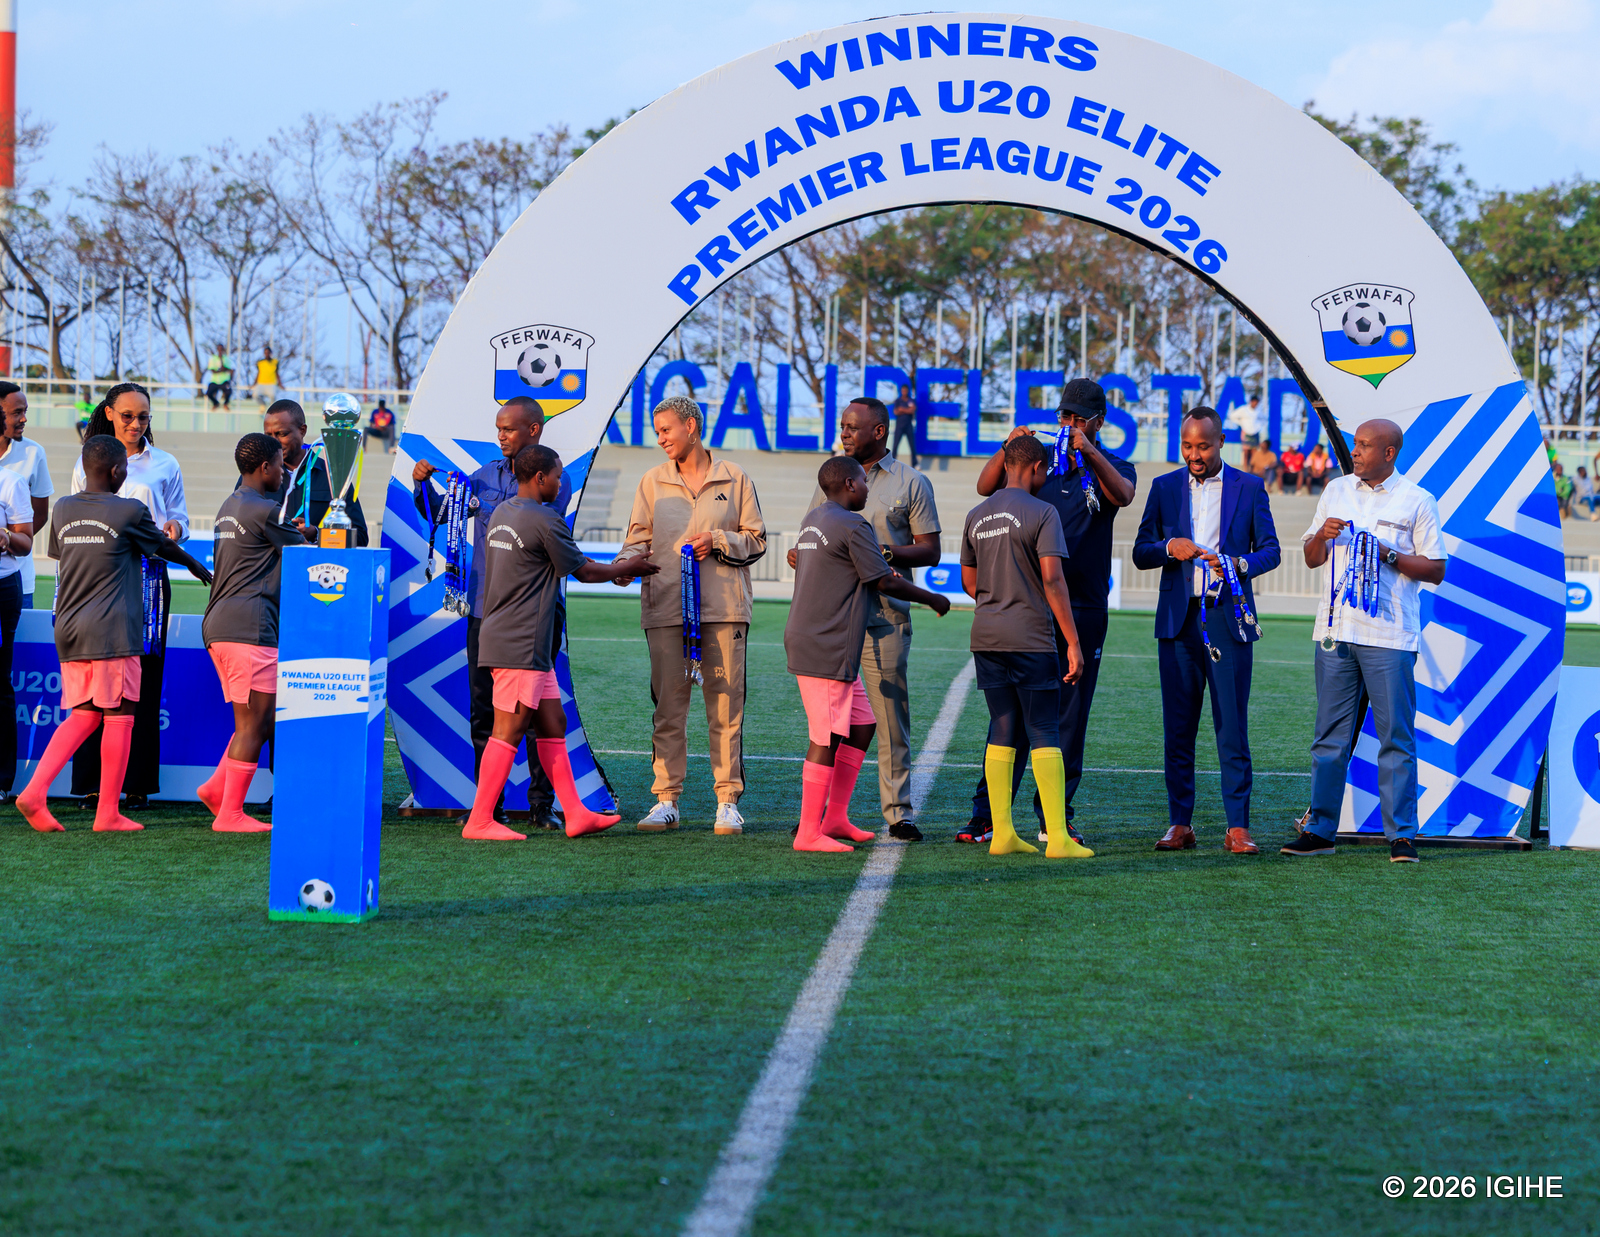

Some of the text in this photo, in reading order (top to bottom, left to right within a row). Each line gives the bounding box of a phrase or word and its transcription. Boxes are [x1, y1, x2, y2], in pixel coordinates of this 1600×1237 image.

[775, 22, 1099, 90] WINNERS
[670, 80, 1221, 226] RWANDA U20 ELITE
[667, 137, 1229, 306] PREMIER LEAGUE 2026
[1321, 287, 1403, 311] FERWAFA
[500, 329, 583, 350] FERWAFA
[606, 359, 838, 452] IGALI
[864, 365, 1065, 458] PELE
[1096, 372, 1339, 467] STAD
[71, 520, 81, 528] FOR
[81, 520, 110, 532] CHAMPIONS
[64, 536, 106, 544] RWAMAGANA
[310, 565, 344, 574] FERWAFA
[11, 671, 62, 693] U20
[282, 671, 321, 680] RWANDA
[323, 672, 340, 680] U20
[342, 674, 366, 682] ELITE
[287, 682, 326, 690] PREMIER
[327, 684, 362, 692] LEAGUE
[313, 693, 336, 701] 2026
